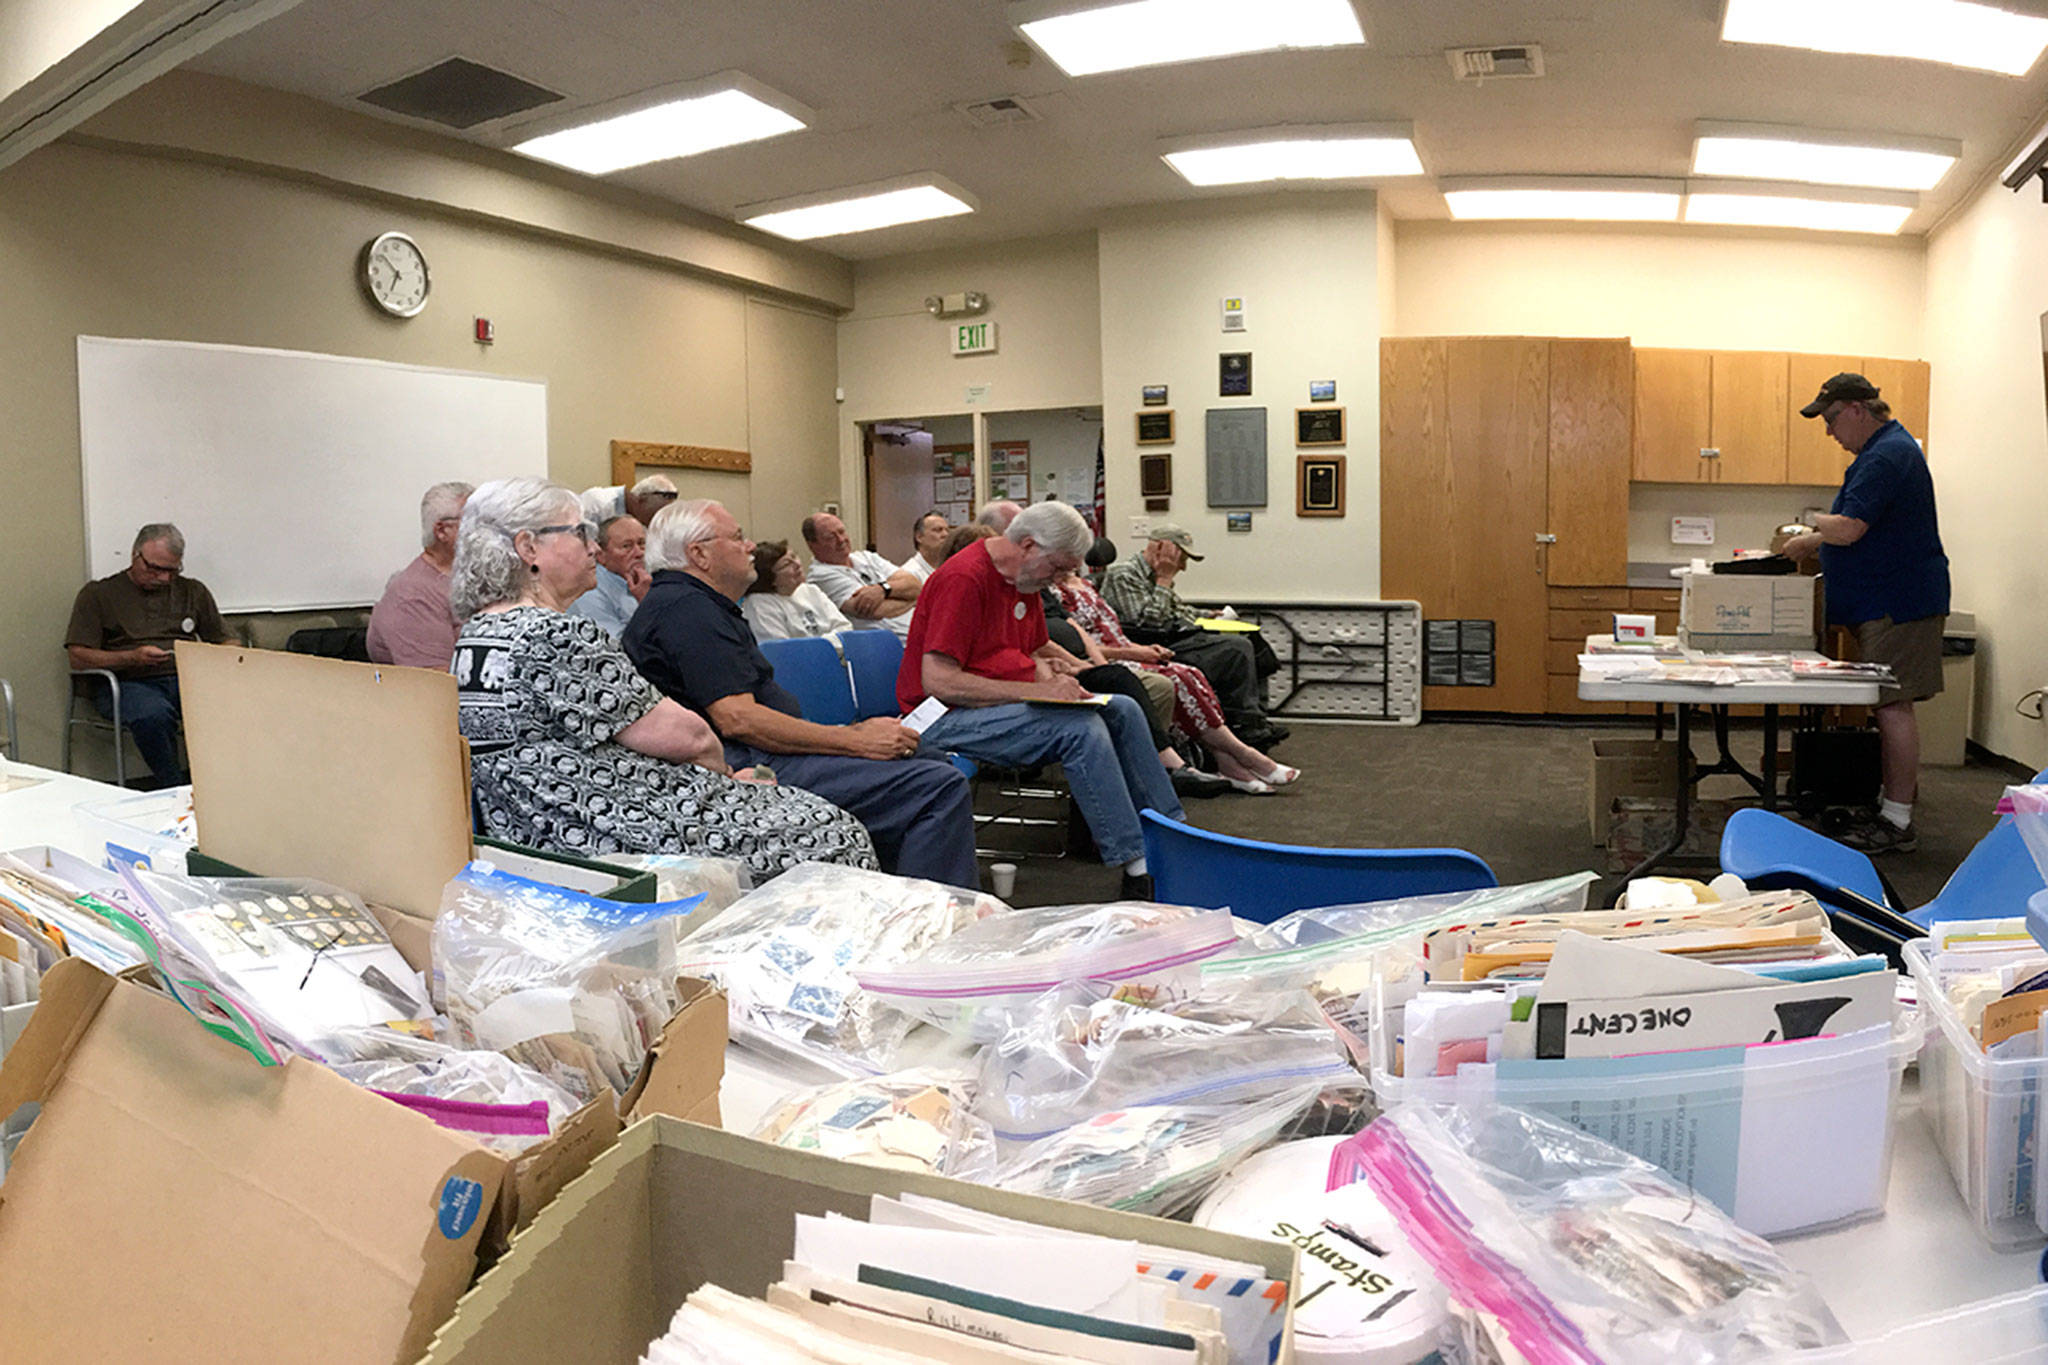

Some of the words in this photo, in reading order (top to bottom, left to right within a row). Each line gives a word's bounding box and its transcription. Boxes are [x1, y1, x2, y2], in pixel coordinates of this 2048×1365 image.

[959, 323, 987, 350] EXIT
[1570, 1012, 1638, 1037] CENT
[1640, 1007, 1691, 1030] ONE
[1271, 1222, 1394, 1294] Stamps
